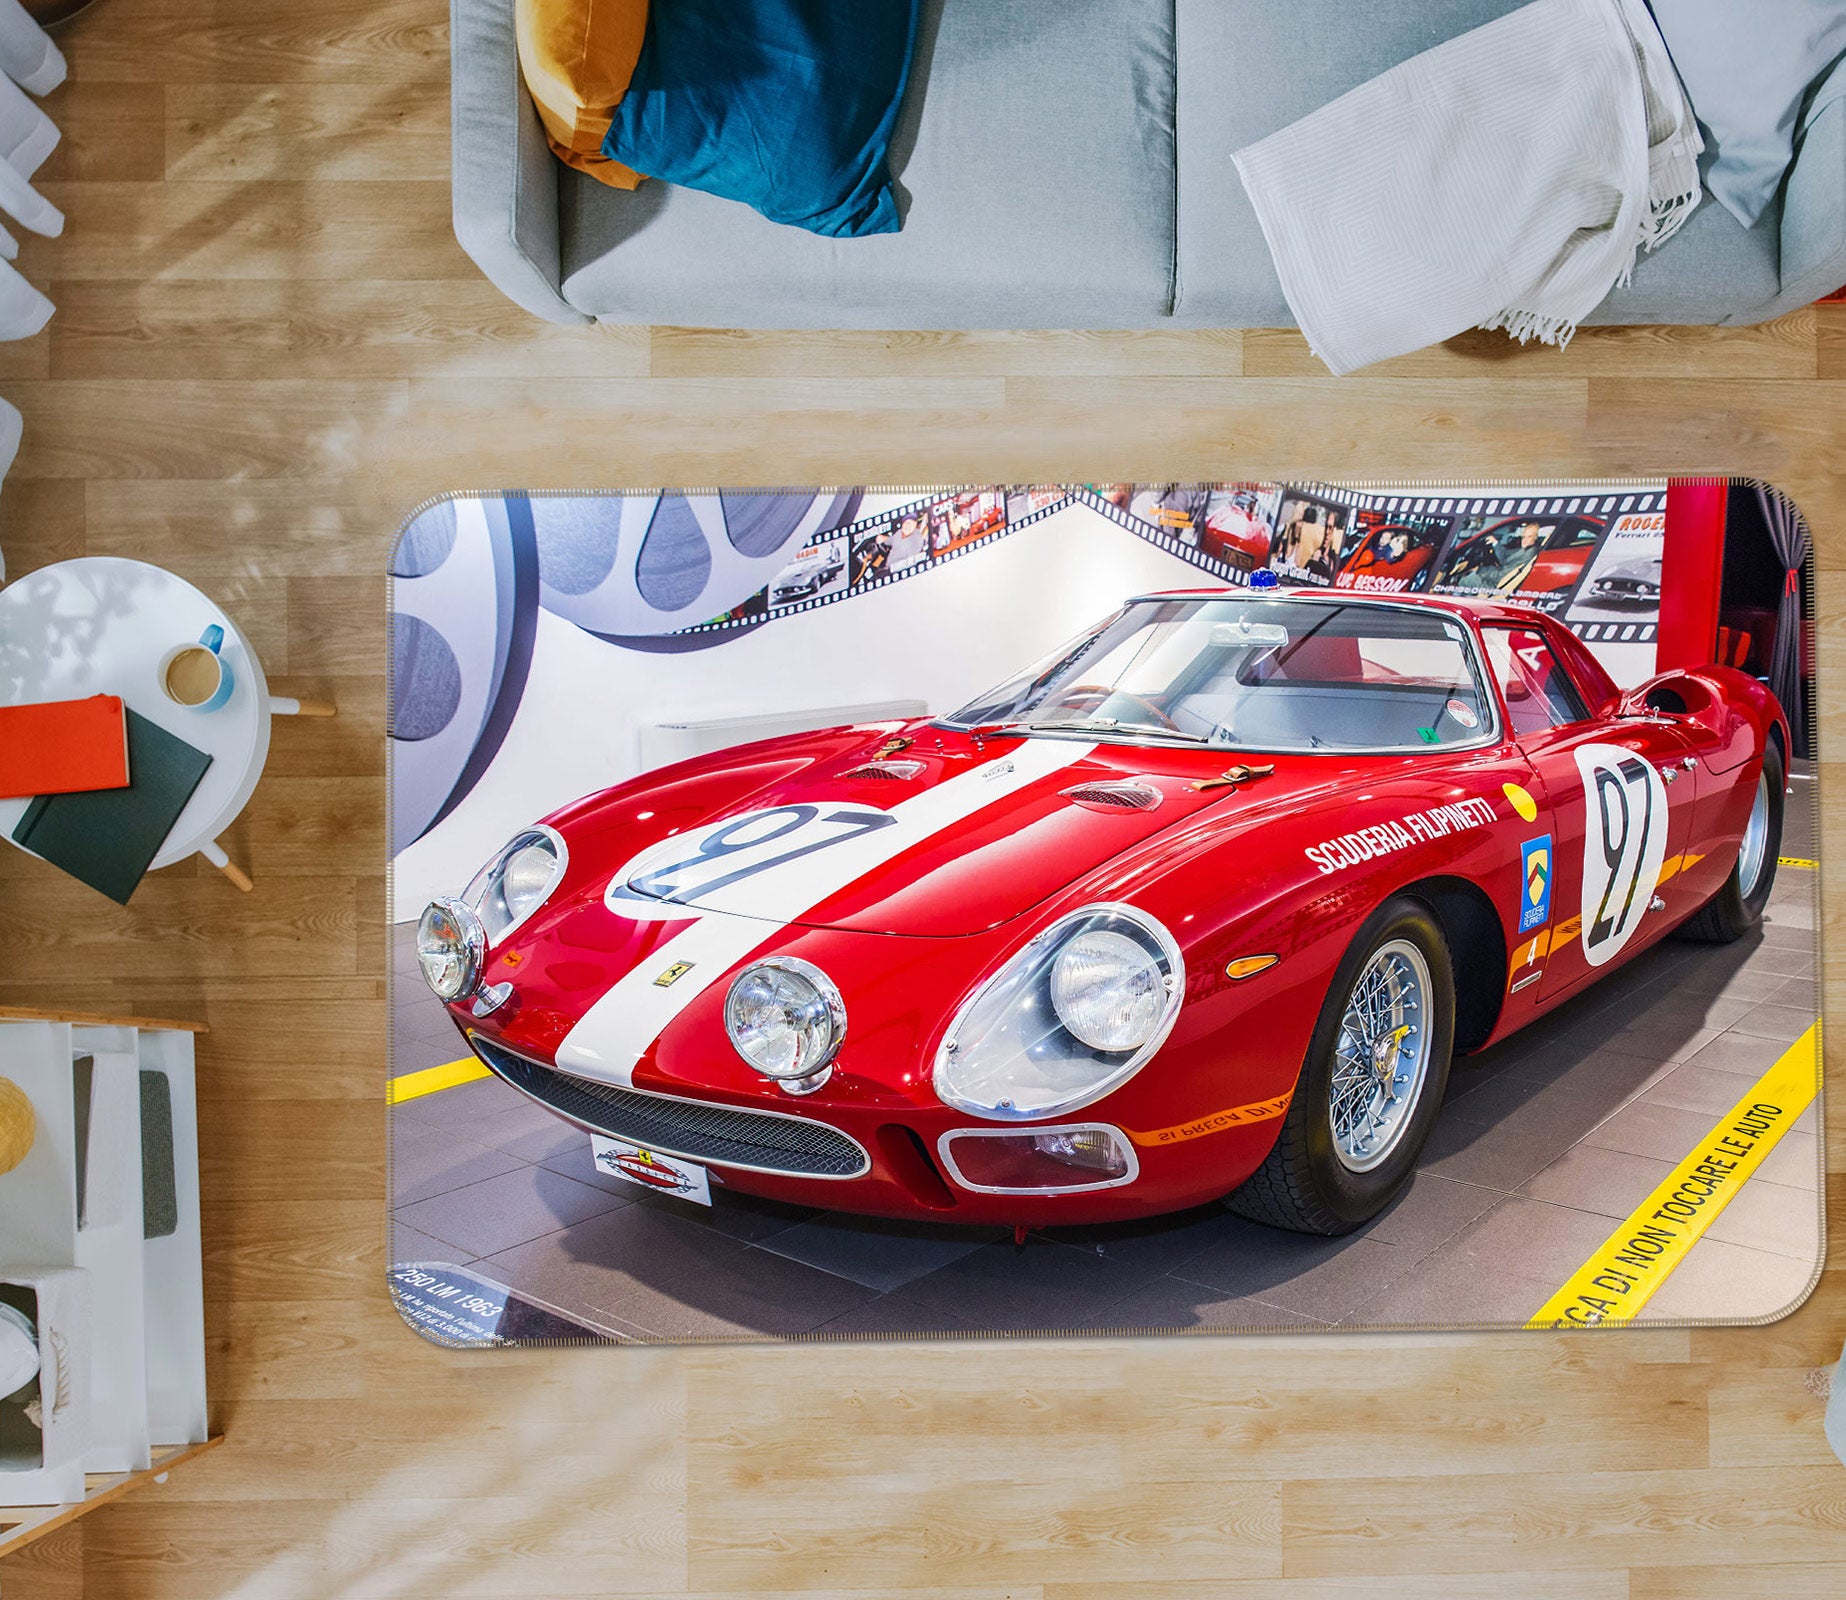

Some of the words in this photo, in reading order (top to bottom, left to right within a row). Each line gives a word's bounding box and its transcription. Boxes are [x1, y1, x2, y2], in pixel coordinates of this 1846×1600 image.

[611, 804, 898, 905] 97
[1304, 815, 1418, 875] SCUDERIA
[1403, 796, 1498, 844] FILIPINETTI
[1588, 757, 1653, 949] 97
[1524, 904, 1545, 921] SCUDERIA
[1732, 1102, 1784, 1139] AUTO
[1713, 1135, 1755, 1159] LE
[1651, 1155, 1738, 1225] TOCCARE
[1614, 1224, 1677, 1270] NON
[394, 1268, 436, 1287] 250
[425, 1281, 463, 1299] LM
[453, 1293, 505, 1317] 1963
[1591, 1267, 1639, 1295] DI
